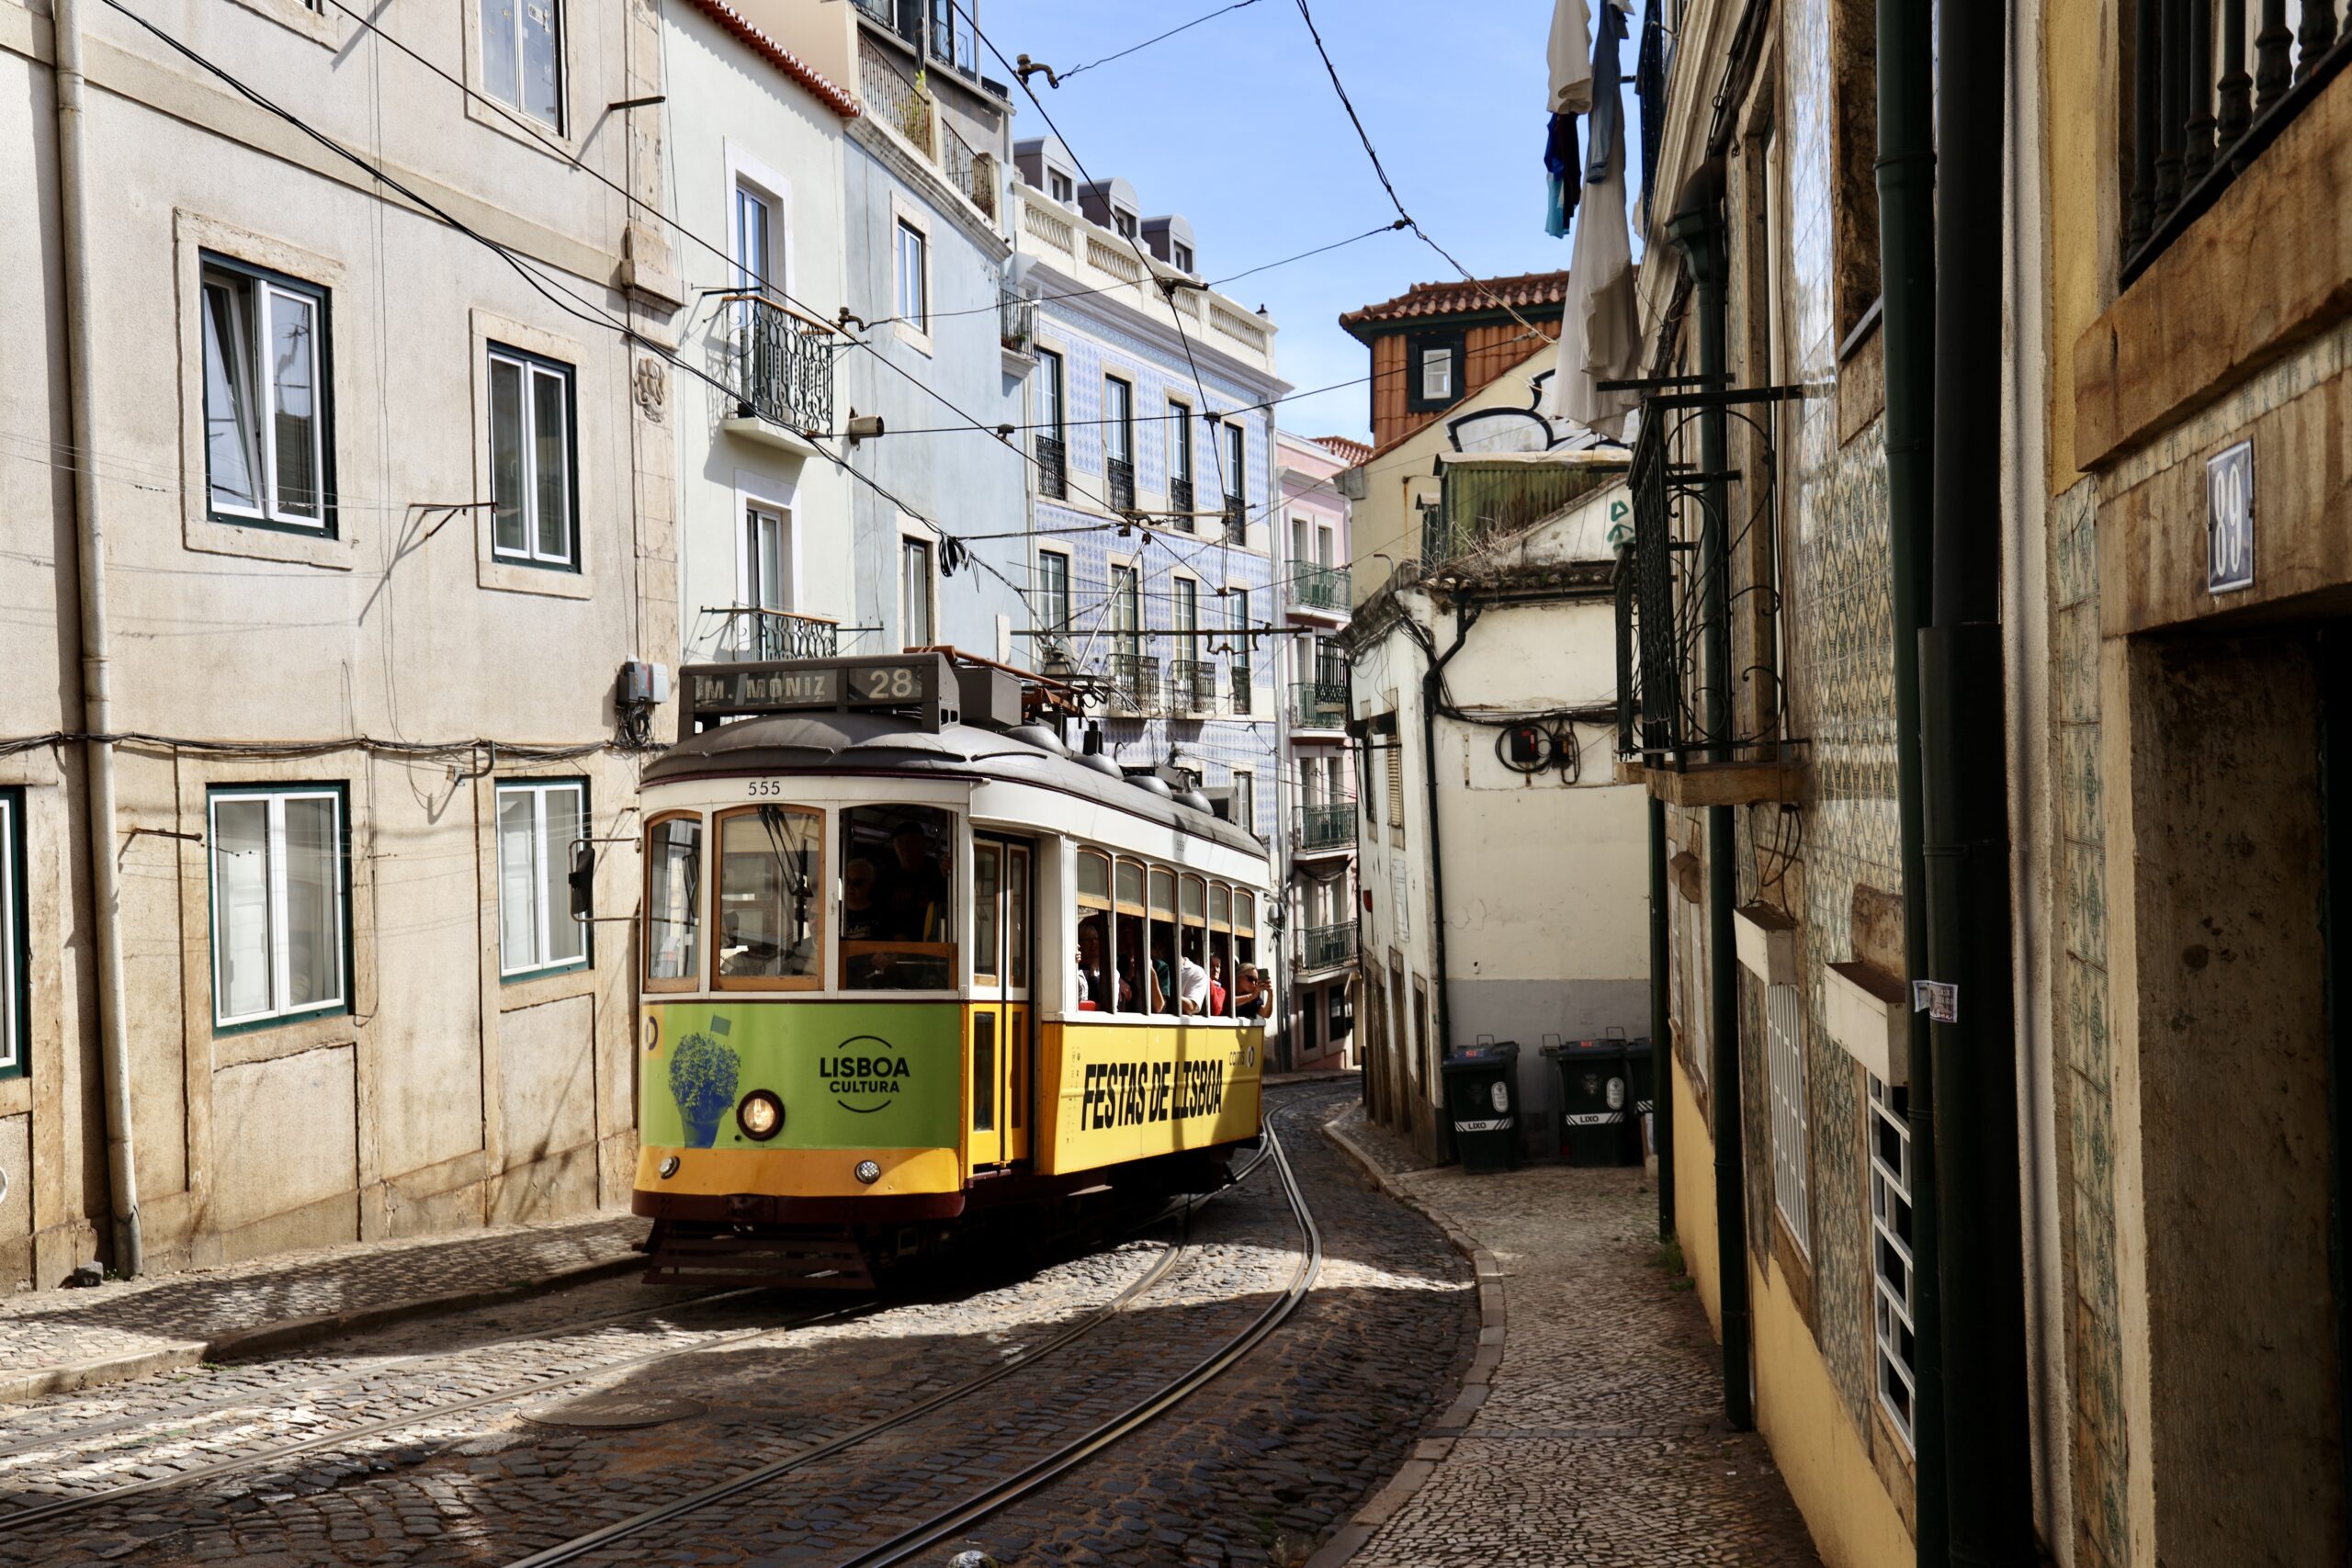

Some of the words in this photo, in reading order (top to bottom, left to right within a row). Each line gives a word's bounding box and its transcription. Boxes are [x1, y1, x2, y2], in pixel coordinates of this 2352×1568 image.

[2214, 462, 2242, 577] 89
[705, 680, 733, 700] M.
[745, 675, 826, 699] MONIZ
[868, 669, 913, 699] 28
[748, 781, 781, 796] 555
[820, 1056, 910, 1078] LISBOA
[829, 1080, 900, 1093] CULTURA
[1081, 1062, 1148, 1131] FESTAS
[1148, 1061, 1171, 1123] DE
[1171, 1059, 1224, 1121] LISBOA
[1468, 1122, 1487, 1131] LIXO
[1579, 1115, 1600, 1123] LIXO
